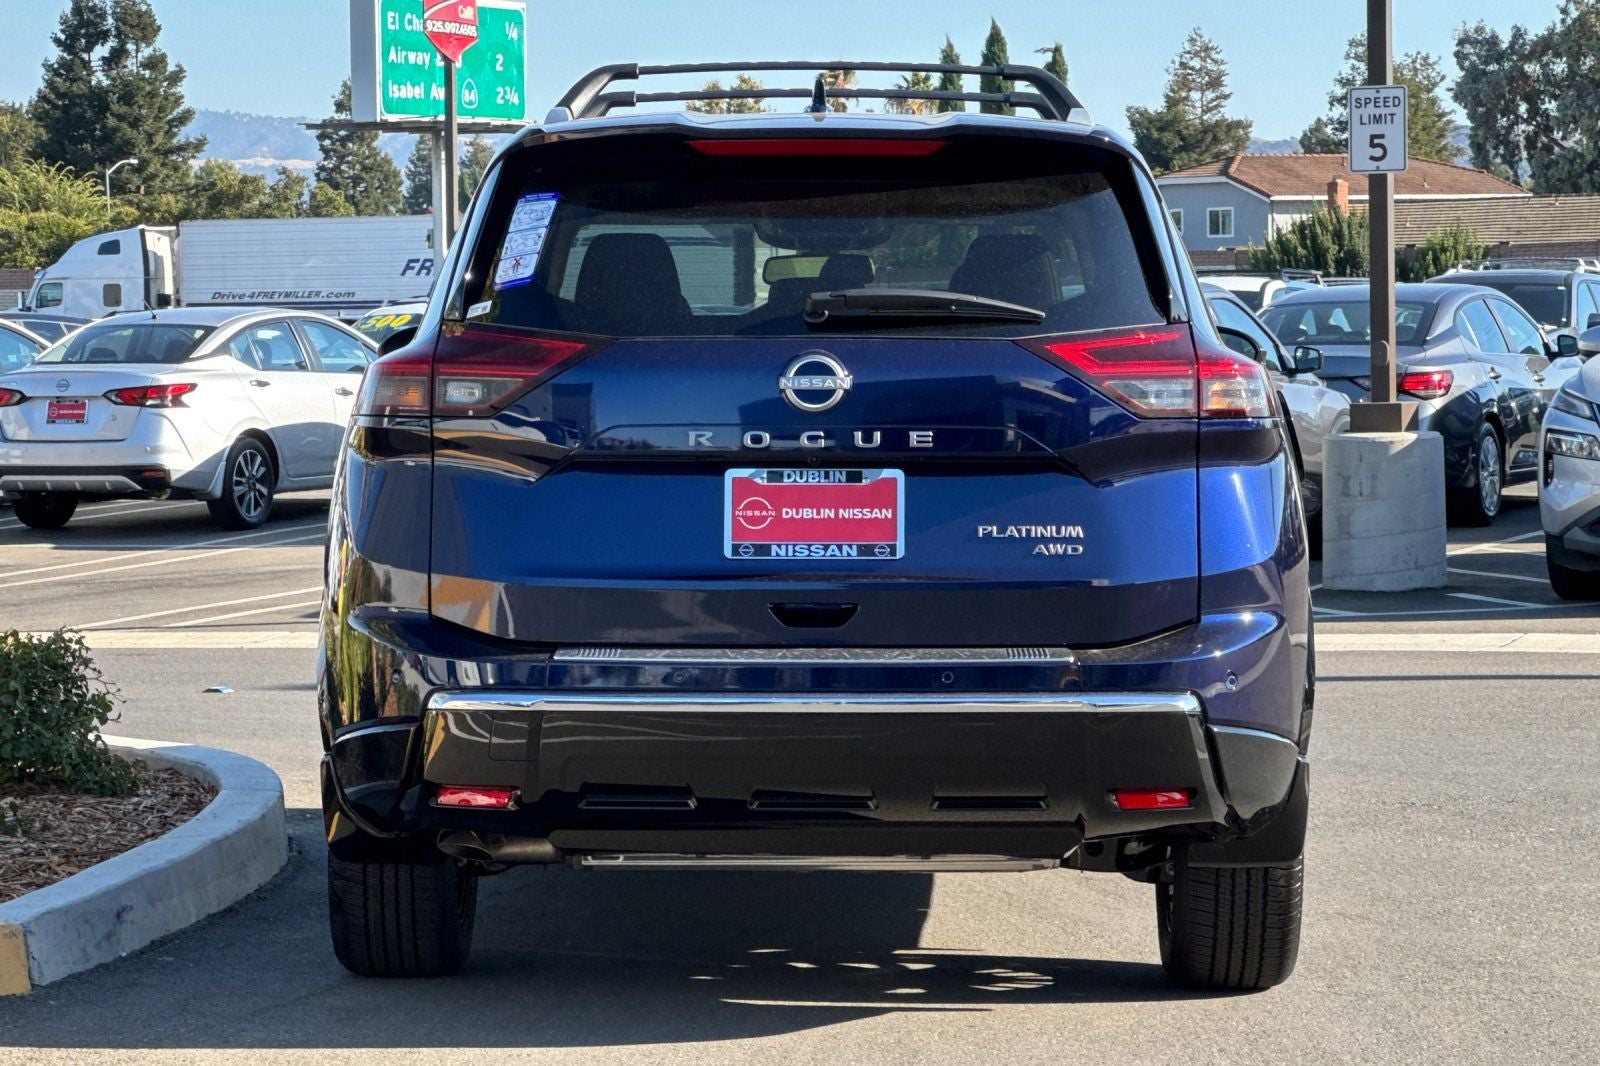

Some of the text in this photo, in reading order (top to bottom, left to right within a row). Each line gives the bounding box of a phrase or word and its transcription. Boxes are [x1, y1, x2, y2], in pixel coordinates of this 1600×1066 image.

[387, 11, 399, 30] El
[388, 45, 431, 71] Airway
[495, 53, 504, 71] 2
[388, 79, 425, 99] Isabel
[464, 88, 475, 103] 84
[1354, 96, 1401, 109] SPEED
[1360, 113, 1396, 125] LIMIT
[1368, 133, 1388, 162] 5
[211, 290, 356, 300] Drive4FREYMILLER.com
[780, 377, 849, 388] NISSAN
[688, 430, 934, 448] ROGUE
[783, 469, 846, 483] DUBLIN
[782, 508, 892, 519] DUBLIN NISSAN
[977, 525, 1084, 538] PLATINUM
[770, 544, 858, 557] NISSAN
[1032, 543, 1084, 555] AWD
